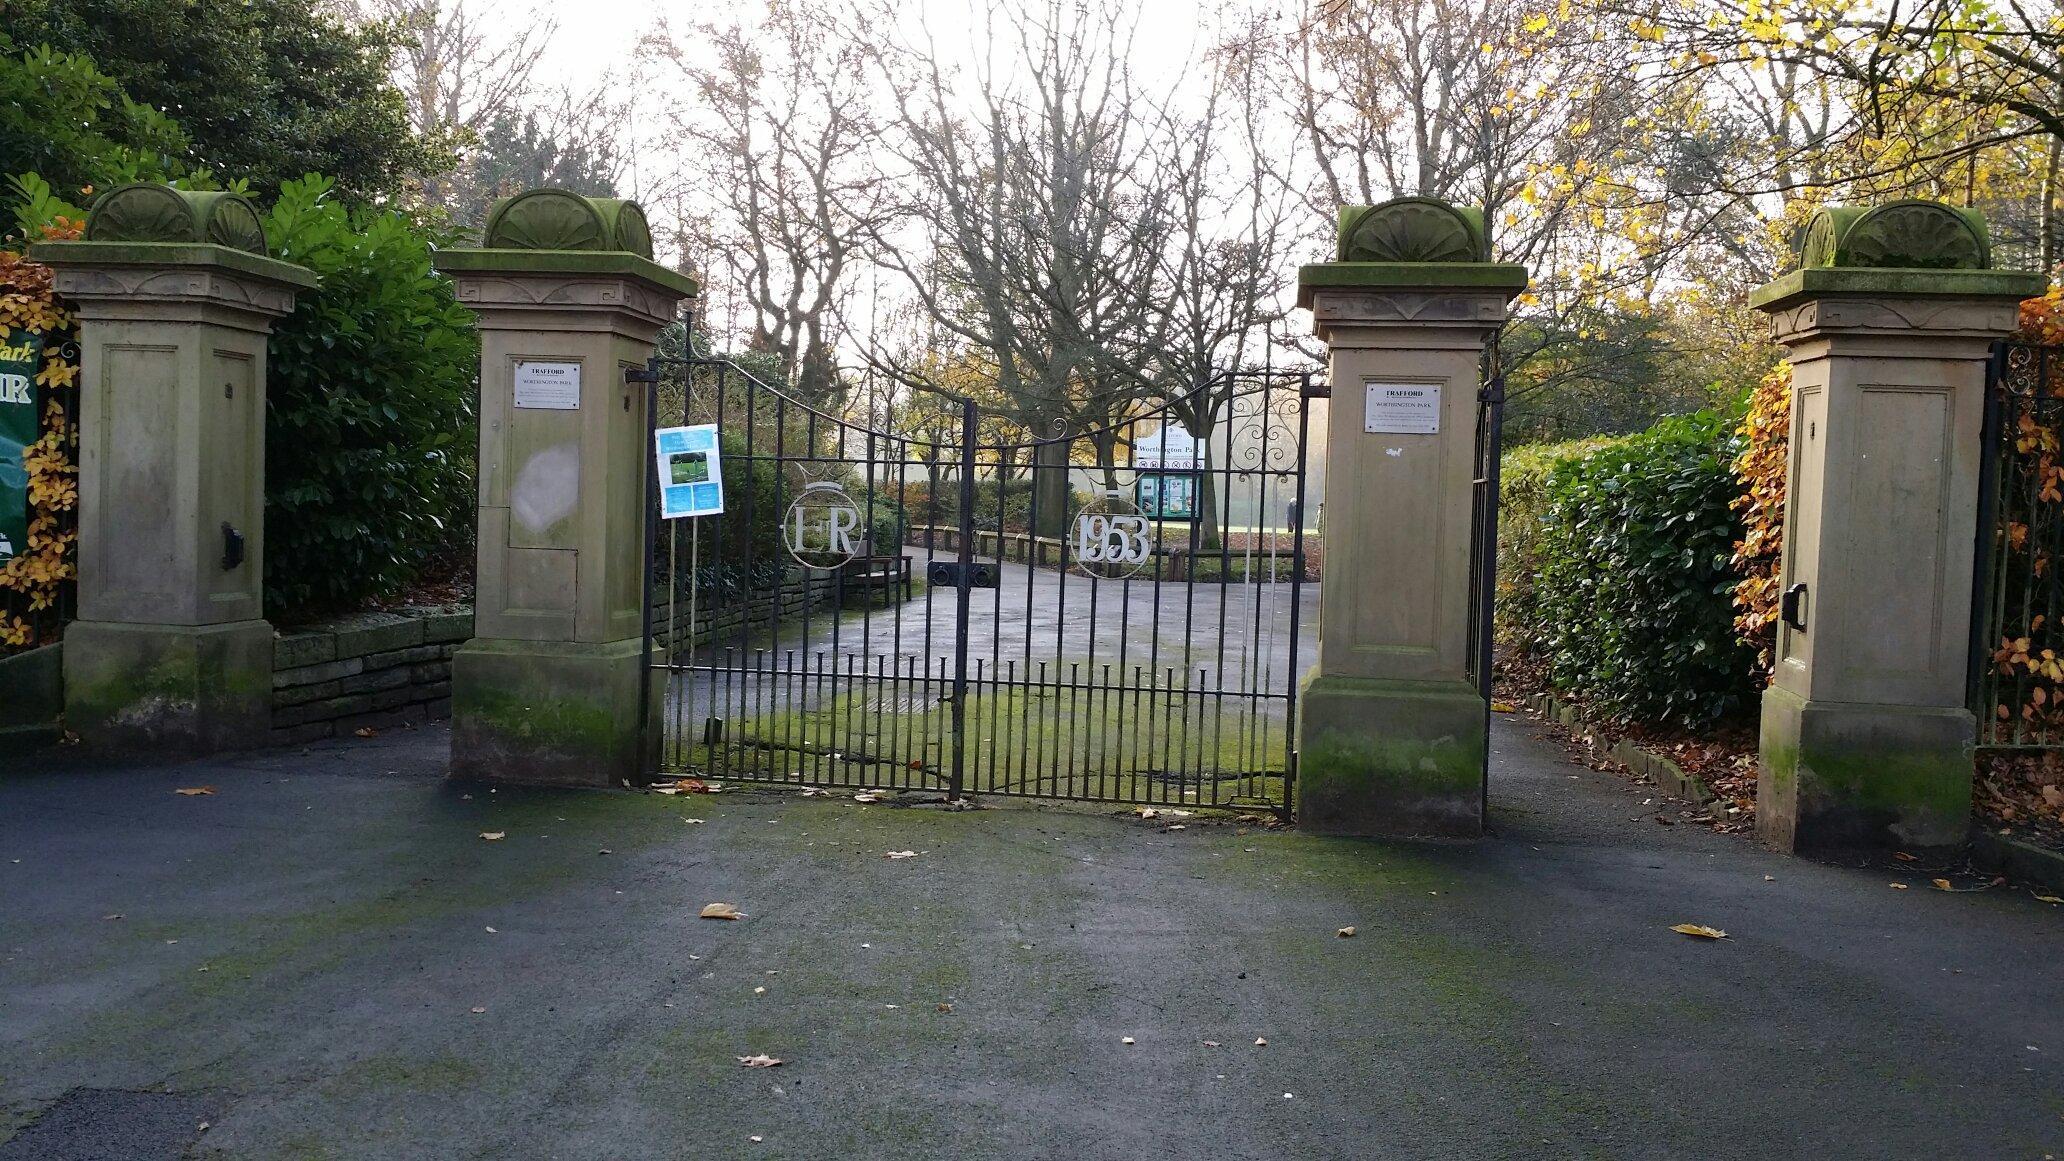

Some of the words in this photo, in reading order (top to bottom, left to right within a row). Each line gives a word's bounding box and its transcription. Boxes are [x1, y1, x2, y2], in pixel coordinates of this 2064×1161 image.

[1138, 445, 1183, 455] Worthgton
[1185, 446, 1201, 454] Pak
[793, 506, 858, 555] ER
[1078, 513, 1149, 565] 1953
